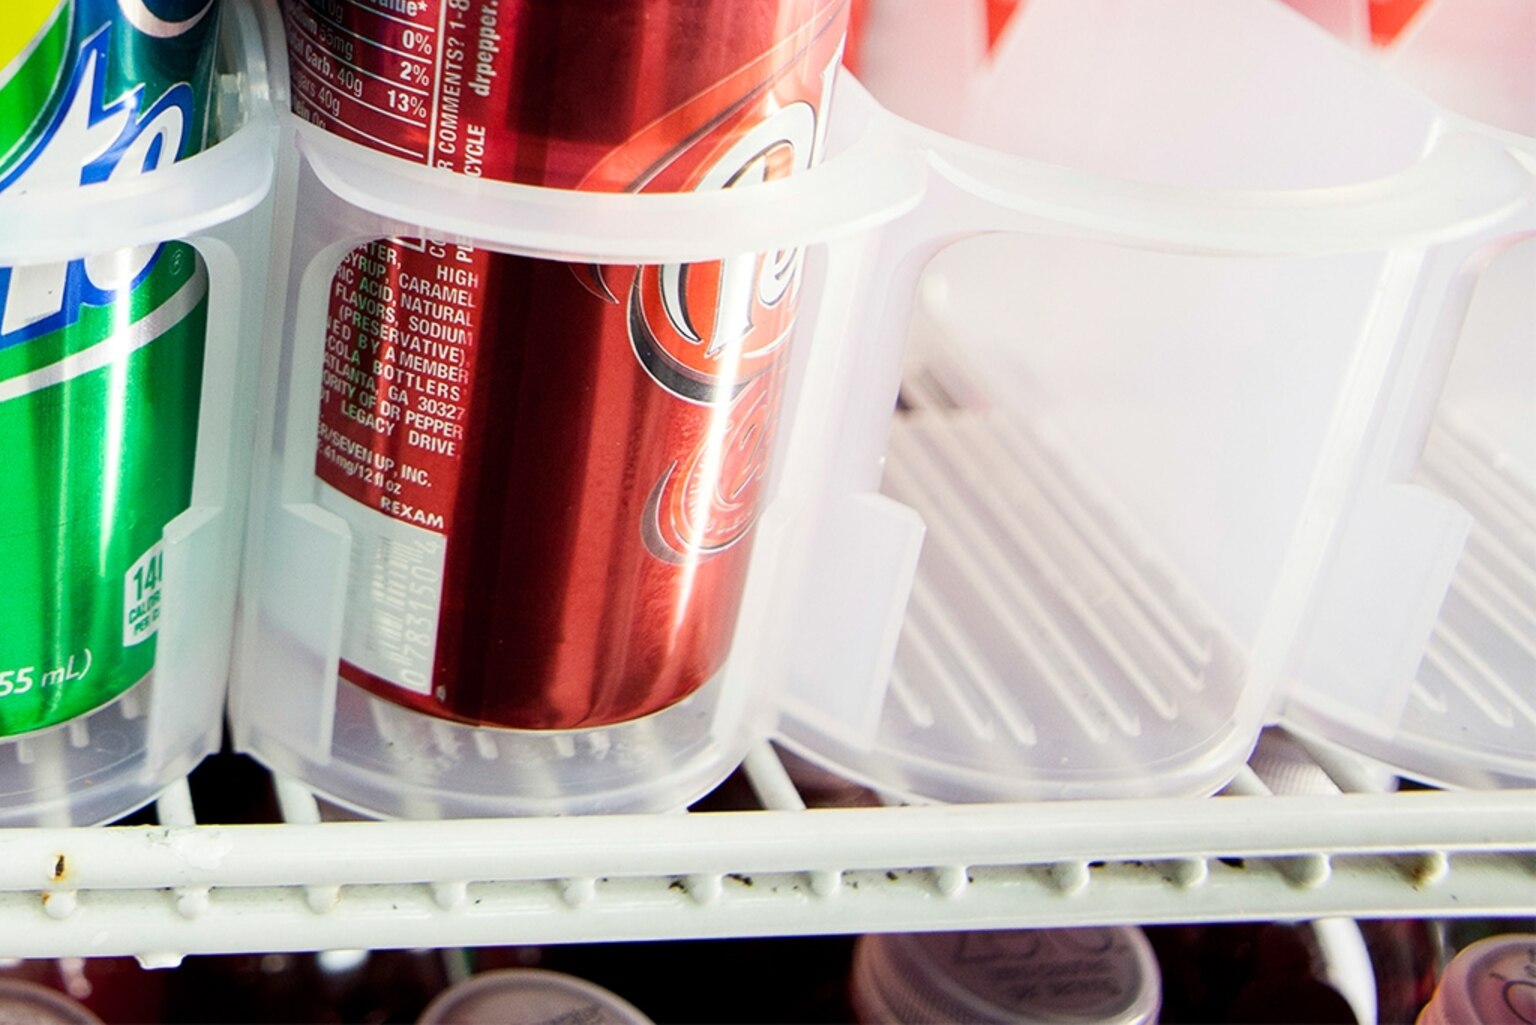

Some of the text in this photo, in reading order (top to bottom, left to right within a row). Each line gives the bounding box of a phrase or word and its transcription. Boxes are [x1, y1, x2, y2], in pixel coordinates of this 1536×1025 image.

[402, 29, 433, 56] 0%
[305, 40, 335, 79] Carb.
[337, 68, 363, 98] 40g
[388, 89, 427, 119] 13%
[399, 61, 430, 87] 2%
[318, 84, 341, 117] 40g
[438, 36, 466, 155] COMMENTS?
[464, 124, 486, 178] CYCLE
[398, 272, 477, 309] CARAMEL
[436, 264, 479, 289] HIGH
[335, 282, 473, 347] FLAVORS, SODIUM
[359, 277, 397, 308] ACID,
[400, 292, 474, 327] NATURAL
[326, 336, 361, 366] COLA
[359, 333, 381, 355] BY
[384, 346, 396, 363] A
[399, 351, 469, 384] MEMBER
[323, 369, 464, 440] ORITY OF DR PEPPER
[341, 399, 395, 436] LEGACY
[388, 385, 409, 406] GA
[418, 396, 466, 421] 30327
[386, 480, 402, 495] oz
[401, 464, 432, 488] INC.
[380, 496, 445, 529] REXAM
[41, 648, 93, 689] mL)
